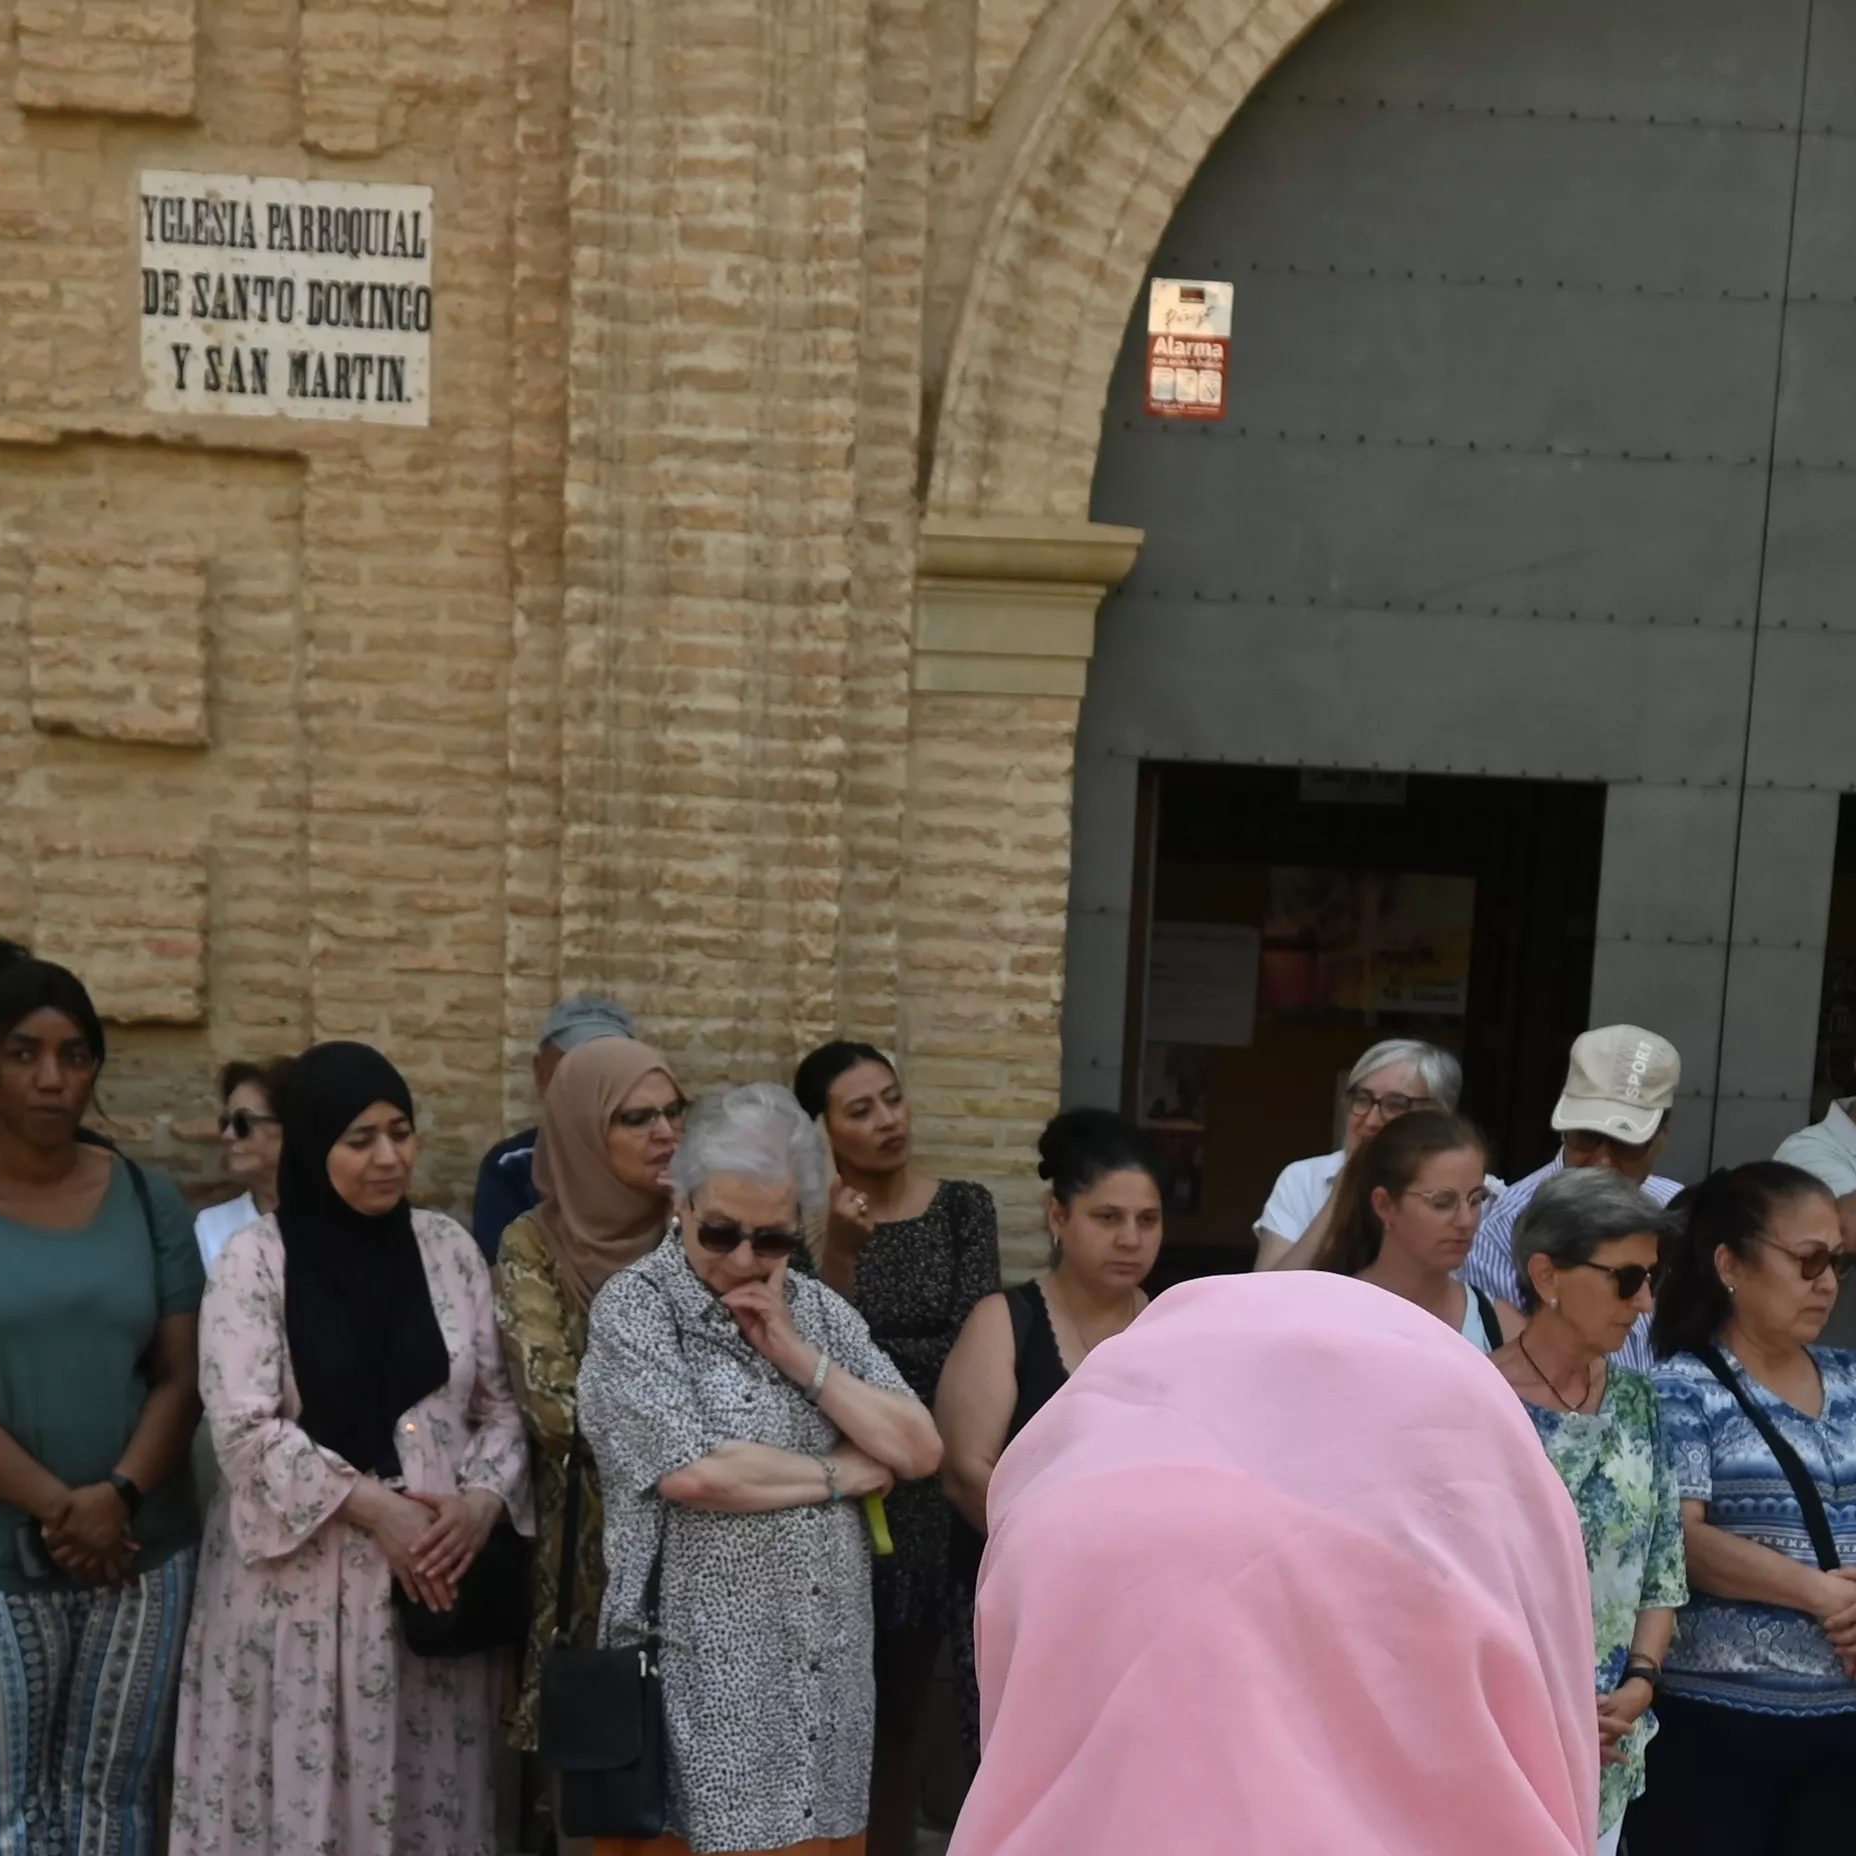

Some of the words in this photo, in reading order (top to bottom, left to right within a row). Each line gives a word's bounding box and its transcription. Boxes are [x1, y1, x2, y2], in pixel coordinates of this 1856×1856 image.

[143, 194, 256, 250] YGLESIA
[266, 202, 426, 259] PARROQUIAL
[142, 268, 181, 317] DE
[192, 271, 295, 323] SANTO
[307, 279, 432, 332] DOMINGO
[171, 343, 190, 390] Y
[205, 345, 268, 395] SAN
[288, 350, 413, 404] MARTIN.
[1152, 336, 1224, 361] Alarma
[1626, 1041, 1653, 1099] SPORT
